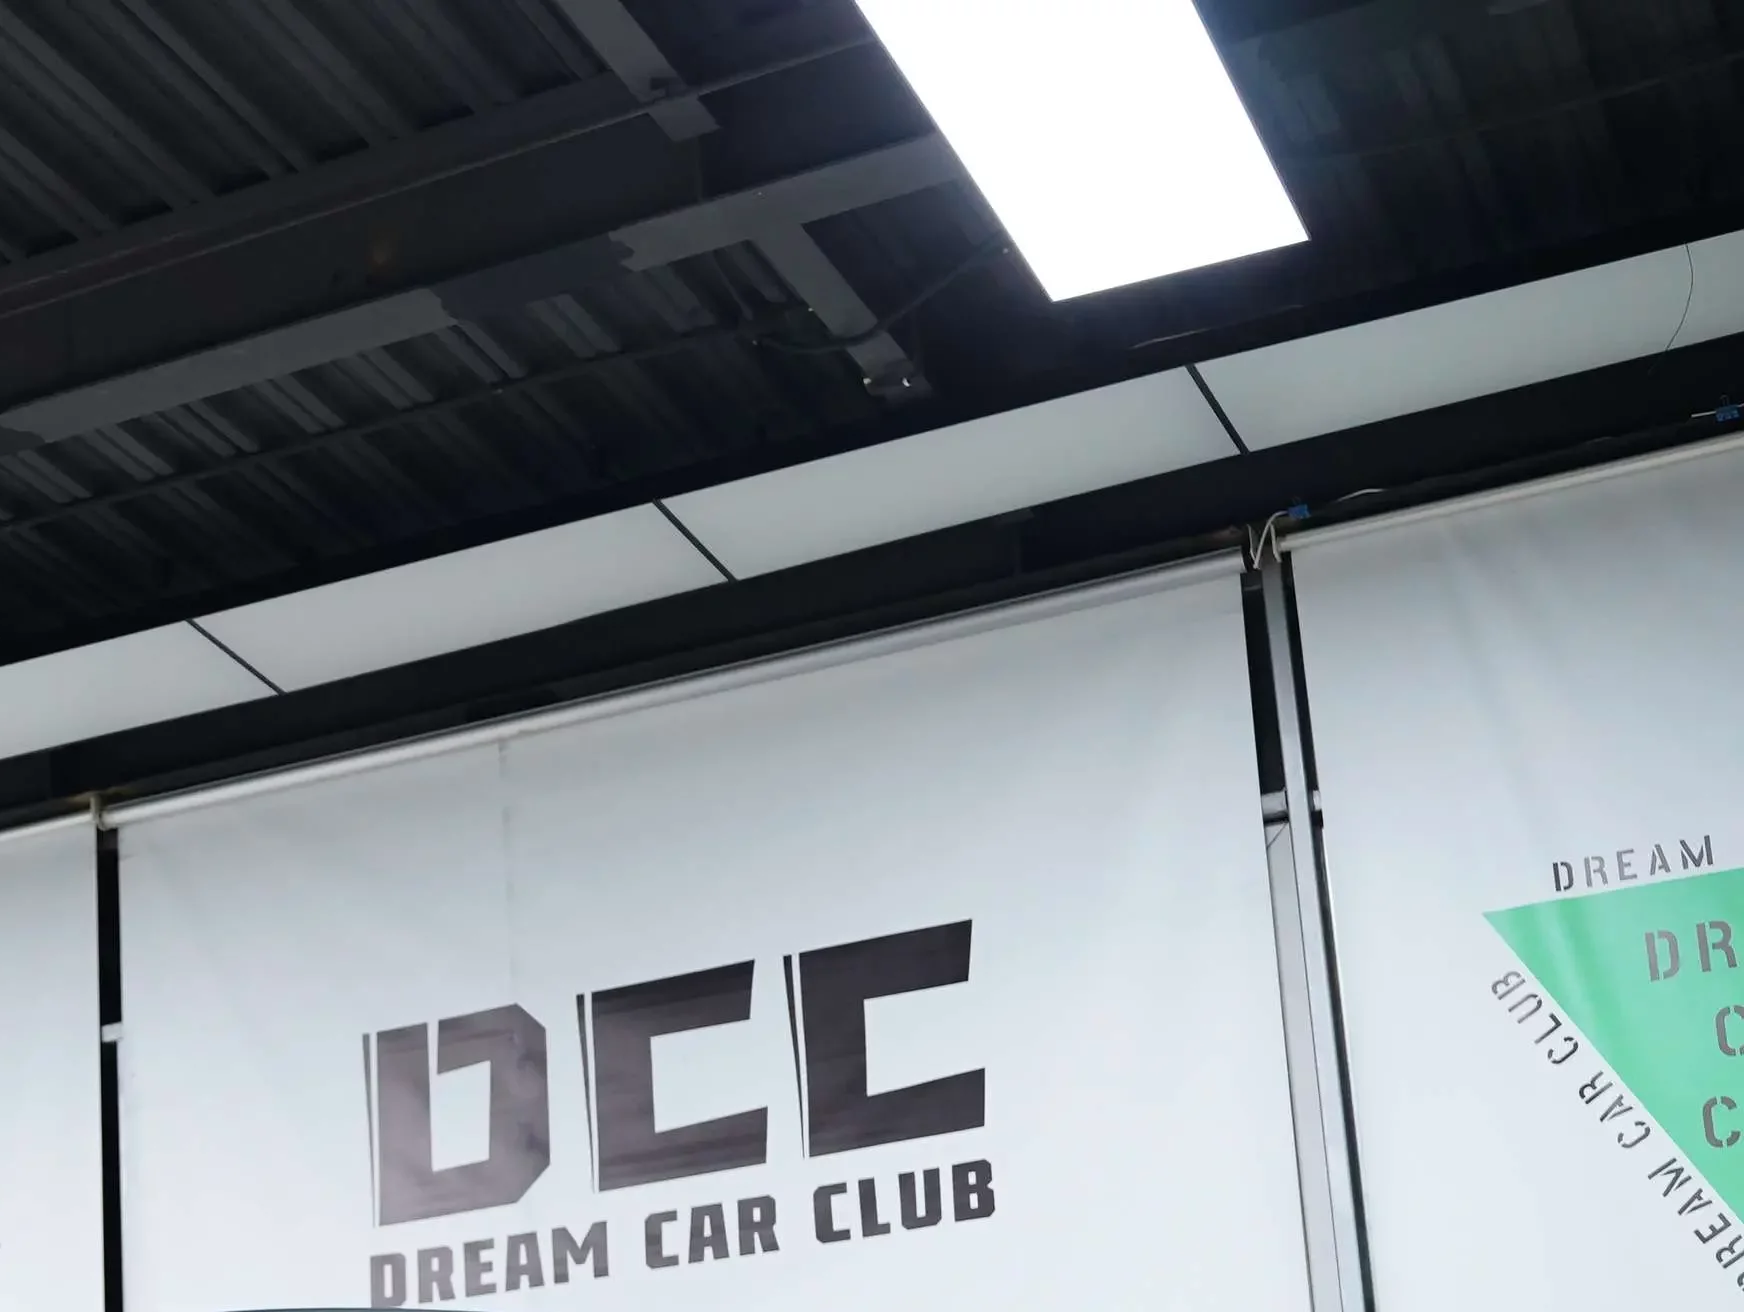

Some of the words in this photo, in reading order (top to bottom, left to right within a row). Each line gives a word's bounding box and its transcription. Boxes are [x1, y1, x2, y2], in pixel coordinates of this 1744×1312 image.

[1552, 835, 1714, 892] DREAM
[1490, 970, 1579, 1065] CLUB
[362, 918, 986, 1228] DCC
[1577, 1070, 1652, 1149] CAR
[370, 1220, 610, 1308] DREAM
[644, 1194, 780, 1270] CAR
[813, 1158, 996, 1244] CLUB
